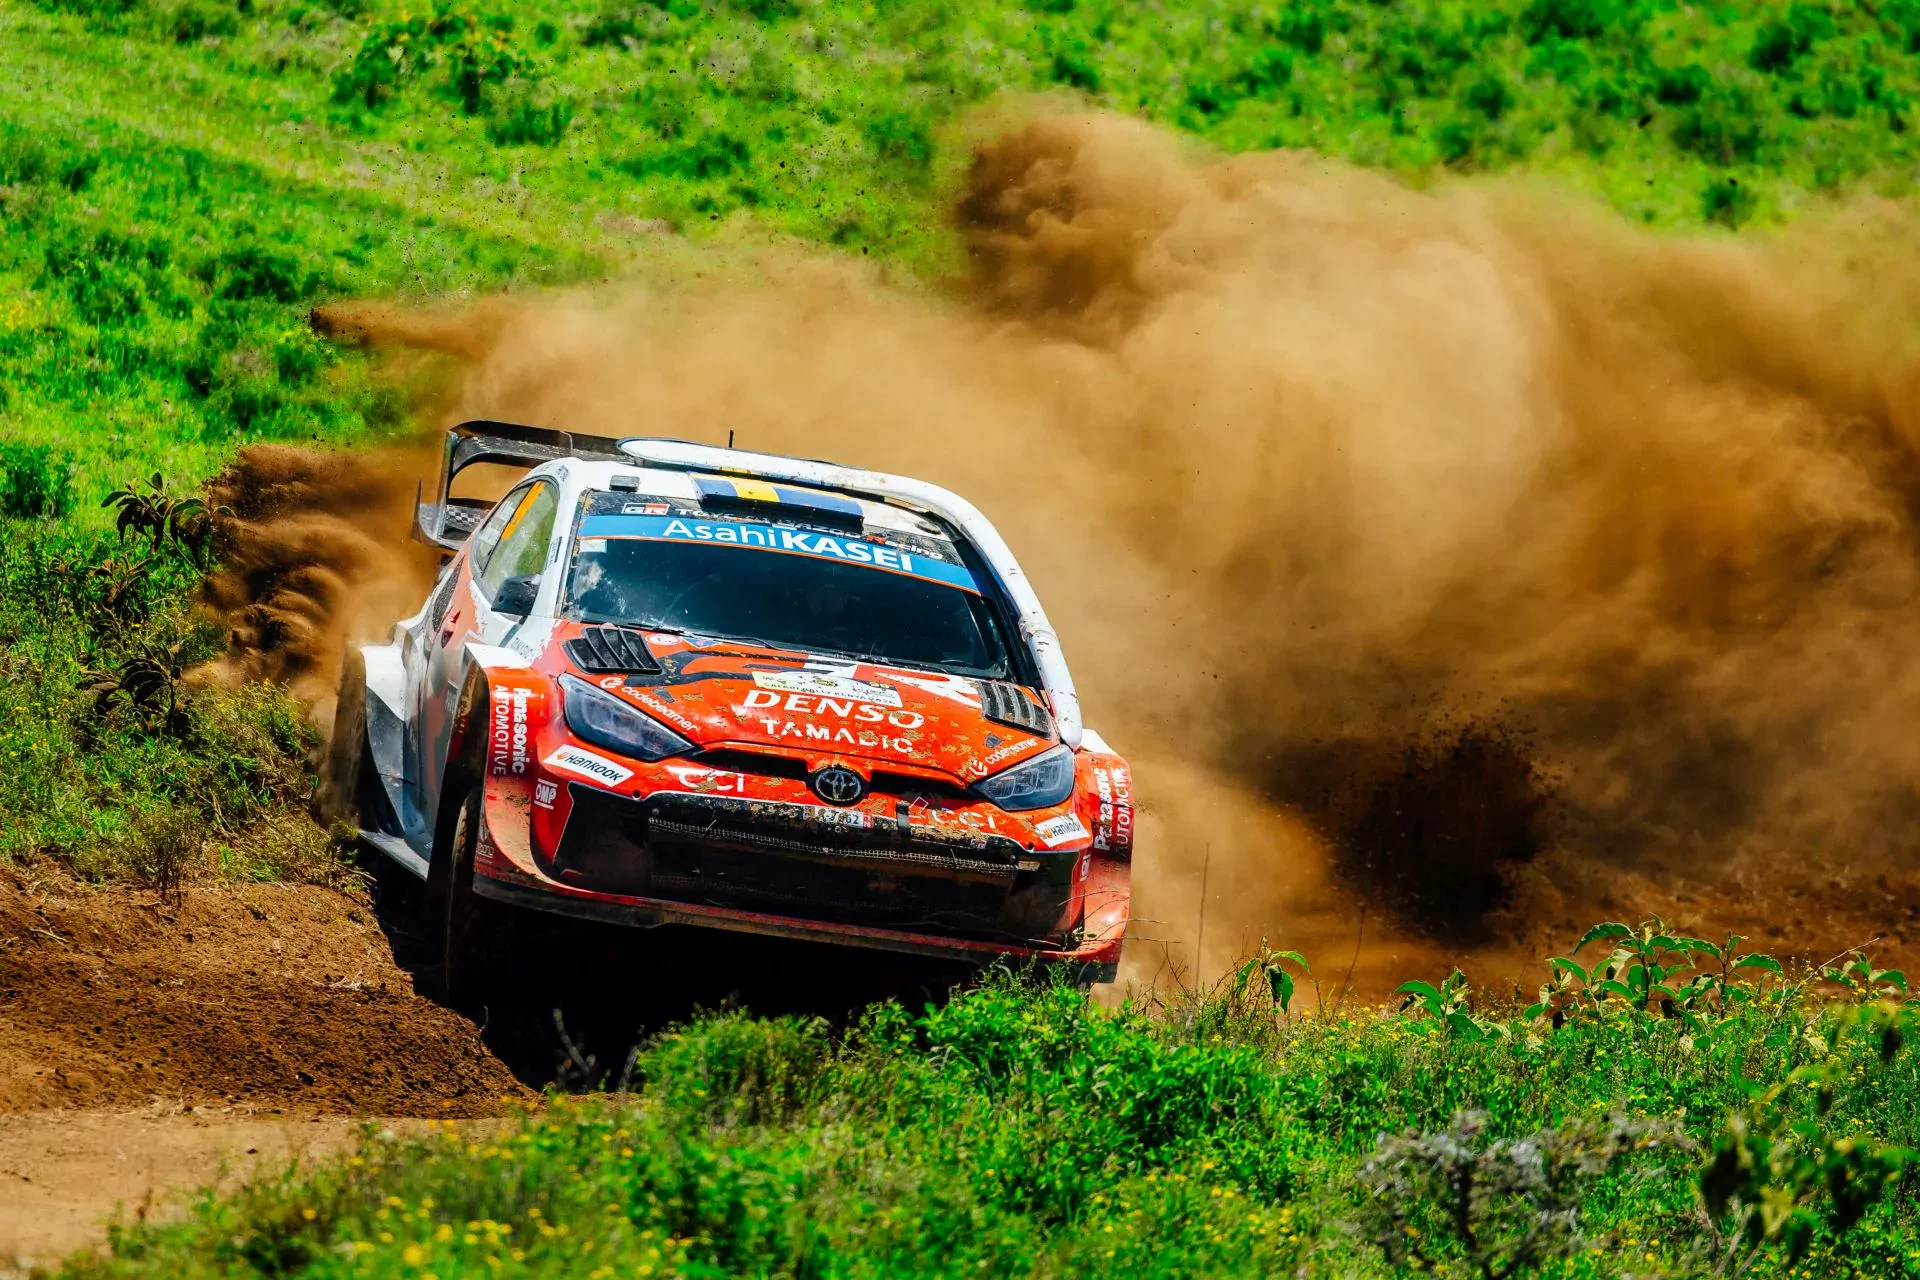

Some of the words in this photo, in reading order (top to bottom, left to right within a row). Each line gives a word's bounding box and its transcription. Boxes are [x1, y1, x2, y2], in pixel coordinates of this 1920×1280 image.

[493, 684, 509, 776] AUTOMOTIVE
[621, 685, 697, 732] codebeamer
[742, 689, 925, 729] DENSO
[512, 687, 531, 774] Panasonic
[759, 718, 913, 753] TAMADIC
[535, 783, 557, 804] OMP
